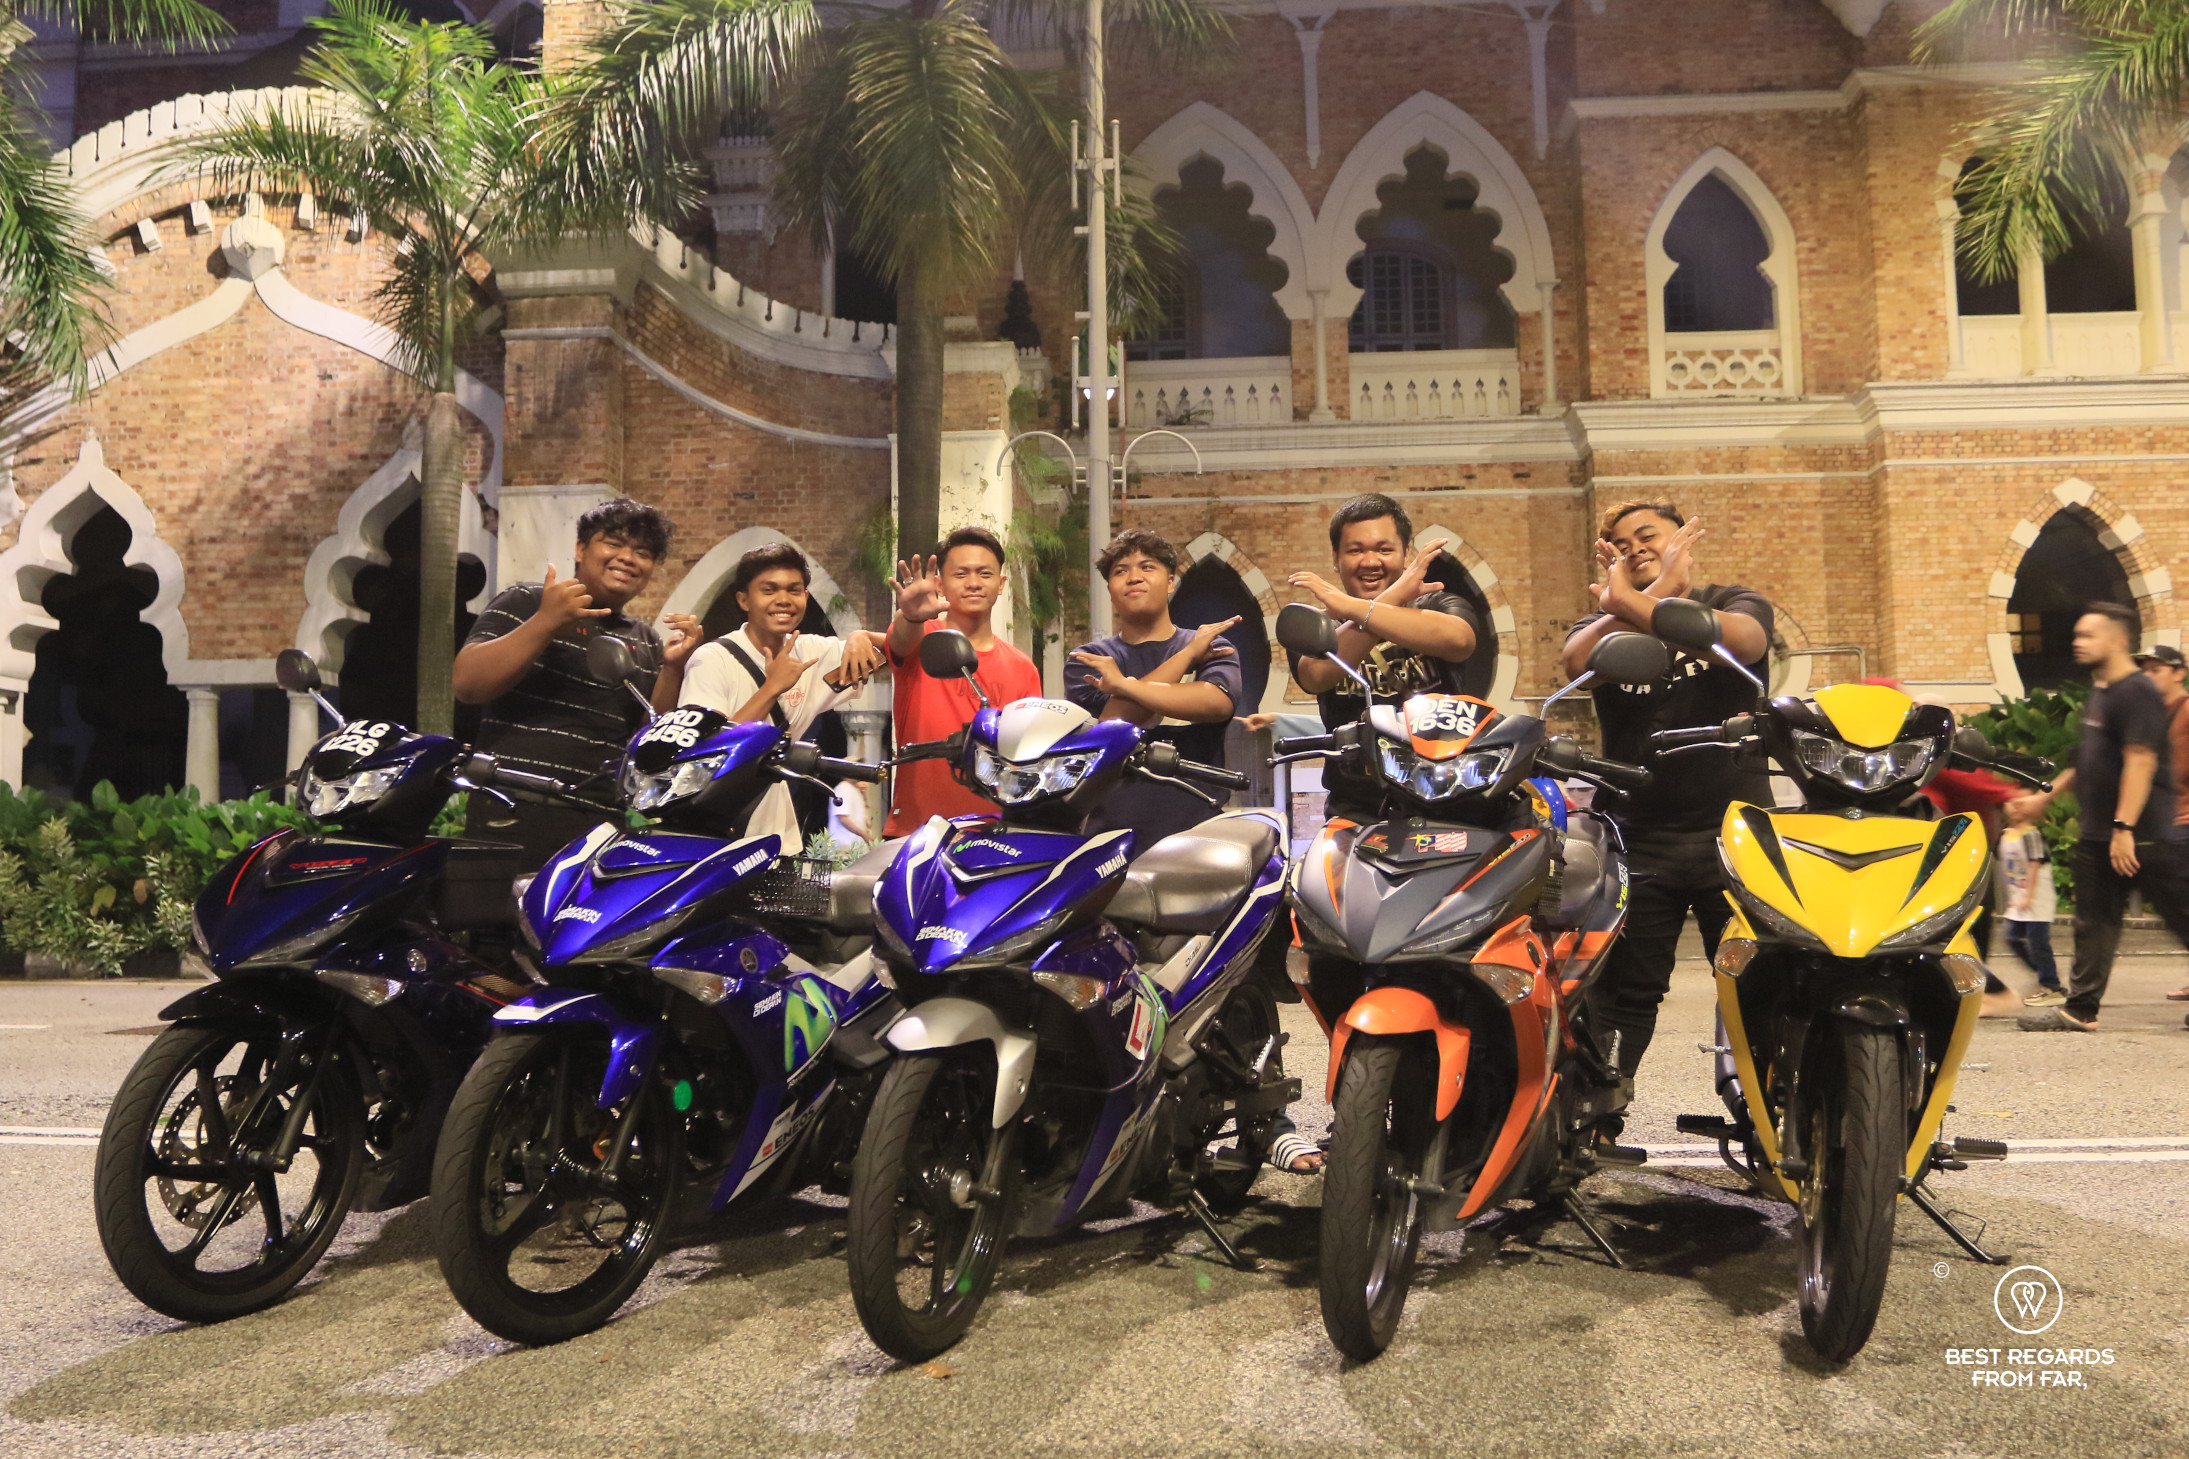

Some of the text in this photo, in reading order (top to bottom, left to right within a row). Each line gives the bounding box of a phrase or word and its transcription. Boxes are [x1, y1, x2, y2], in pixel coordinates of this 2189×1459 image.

[1024, 701, 1069, 715] ENEOS
[654, 709, 704, 727] BRD
[1410, 713, 1476, 736] 1636
[638, 724, 700, 748] 6456
[970, 839, 1022, 857] movistar
[732, 849, 769, 876] YAMAHA
[1095, 851, 1127, 878] YAMAHA
[919, 926, 968, 942] SEMAKIN
[925, 932, 967, 948] DEPAN
[754, 990, 782, 1009] SEMAKIN
[761, 997, 782, 1014] DEPAN
[774, 1105, 816, 1150] ENEOS
